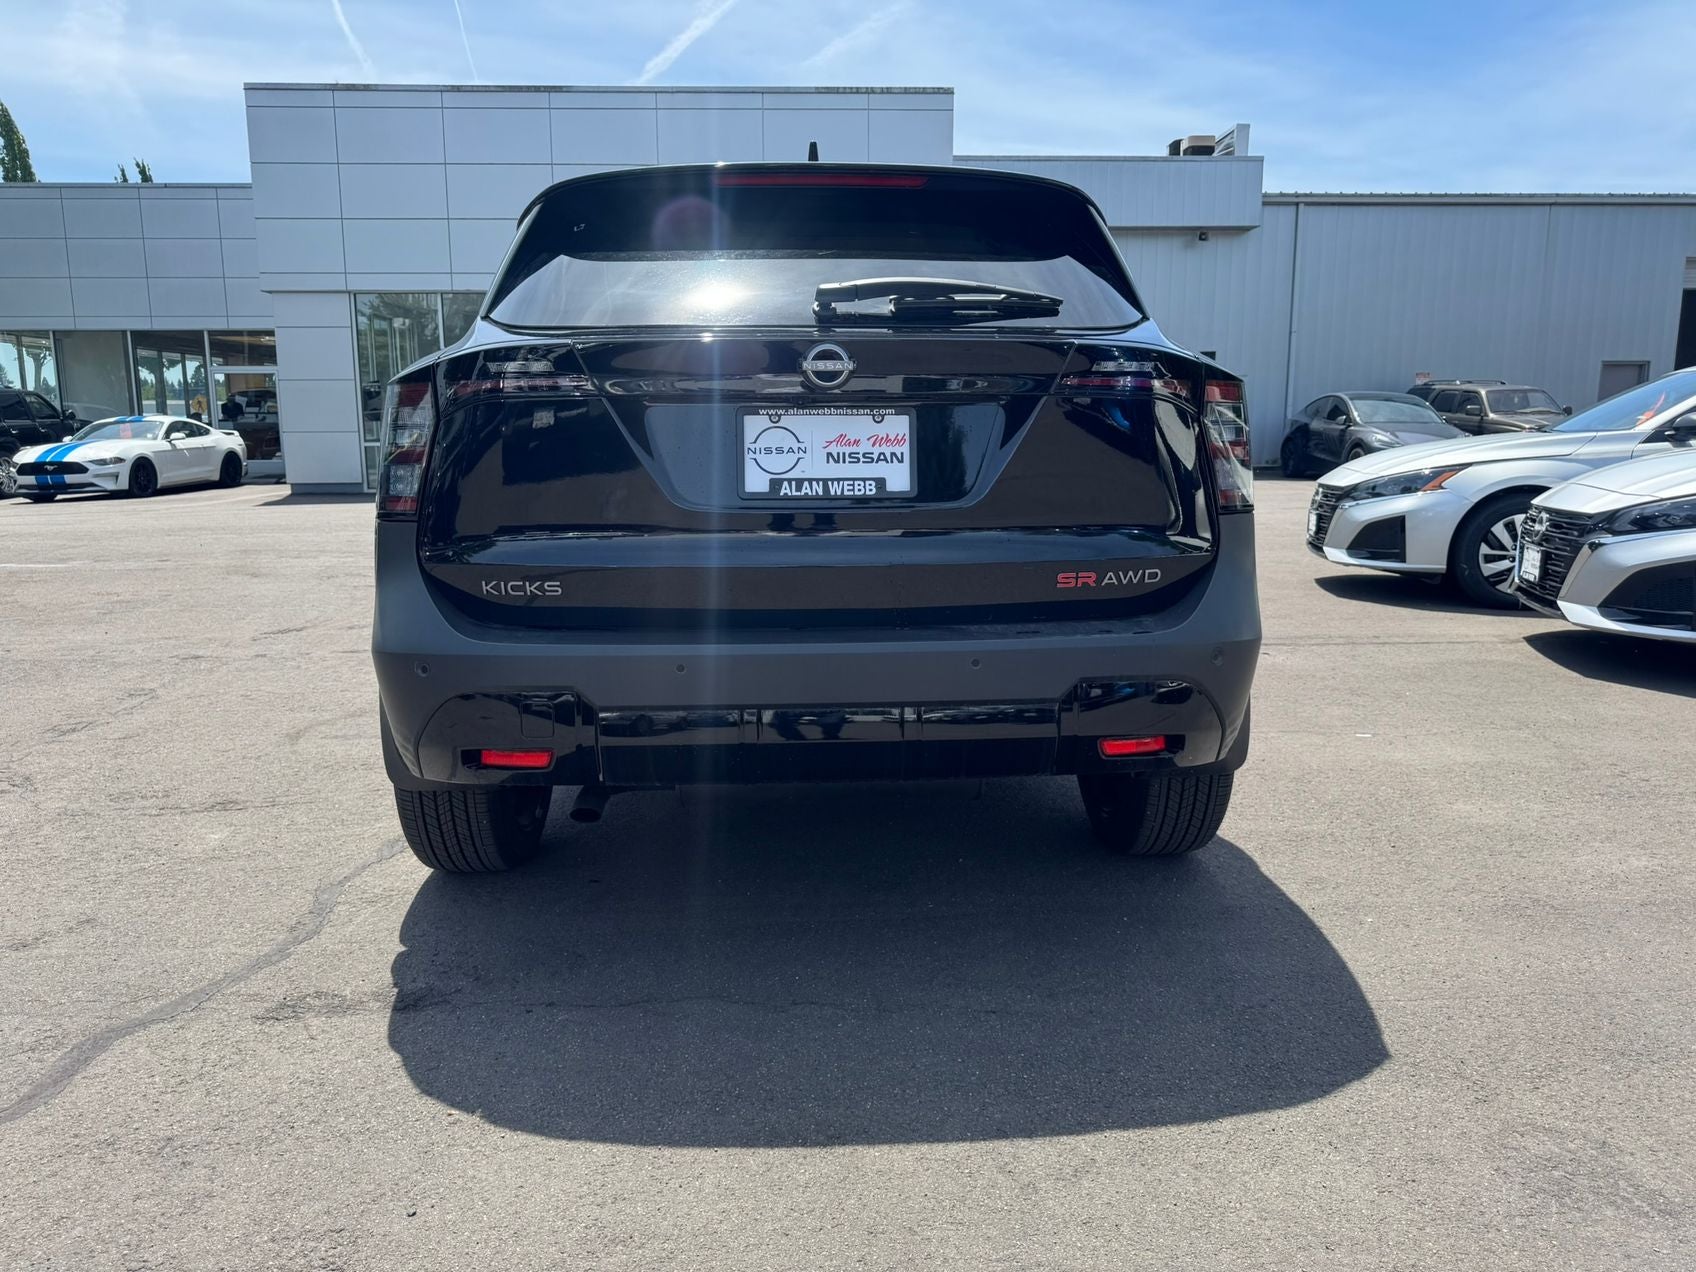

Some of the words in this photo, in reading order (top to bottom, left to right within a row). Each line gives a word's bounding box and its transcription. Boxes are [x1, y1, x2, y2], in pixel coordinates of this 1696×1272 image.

[803, 362, 853, 370] NISSAN
[759, 407, 896, 415] www.alanwebbnissan.com
[822, 433, 861, 449] Alan
[866, 432, 907, 448] Webb
[747, 446, 807, 455] NISSAN
[826, 451, 904, 464] NISSAN
[780, 481, 823, 496] ALAN
[827, 480, 877, 495] WEBB
[1056, 572, 1097, 588] SR
[1101, 568, 1162, 586] AWD
[481, 580, 562, 596] KICKS
